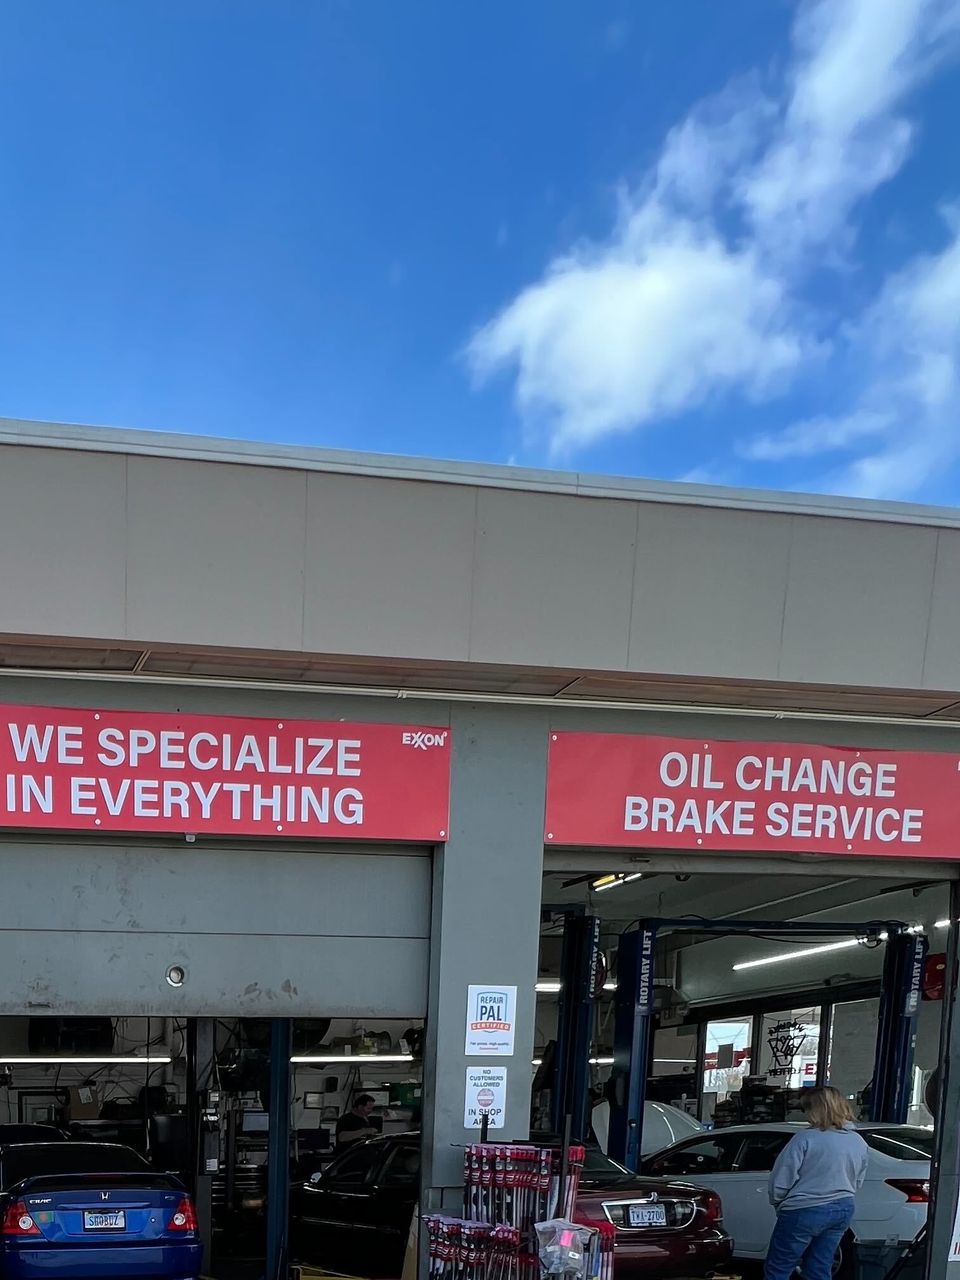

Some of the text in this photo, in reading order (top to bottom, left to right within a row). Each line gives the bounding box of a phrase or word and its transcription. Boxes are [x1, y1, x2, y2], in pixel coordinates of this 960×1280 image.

[7, 723, 362, 777] WE SPECIALIZE
[402, 731, 445, 750] EXXON
[659, 751, 897, 797] OIL CHANGE
[5, 773, 364, 825] IN EVERYTHING
[623, 795, 924, 842] BRAKE SERVICE
[590, 945, 599, 992] ROTARY
[640, 930, 652, 1004] ROTARY LIFT
[909, 935, 924, 1006] ROTARY LIFT
[480, 996, 504, 1004] REPAIR
[480, 1005, 502, 1021] PAL
[472, 1022, 509, 1030] CERTIFIED
[478, 1108, 502, 1116] SHOP
